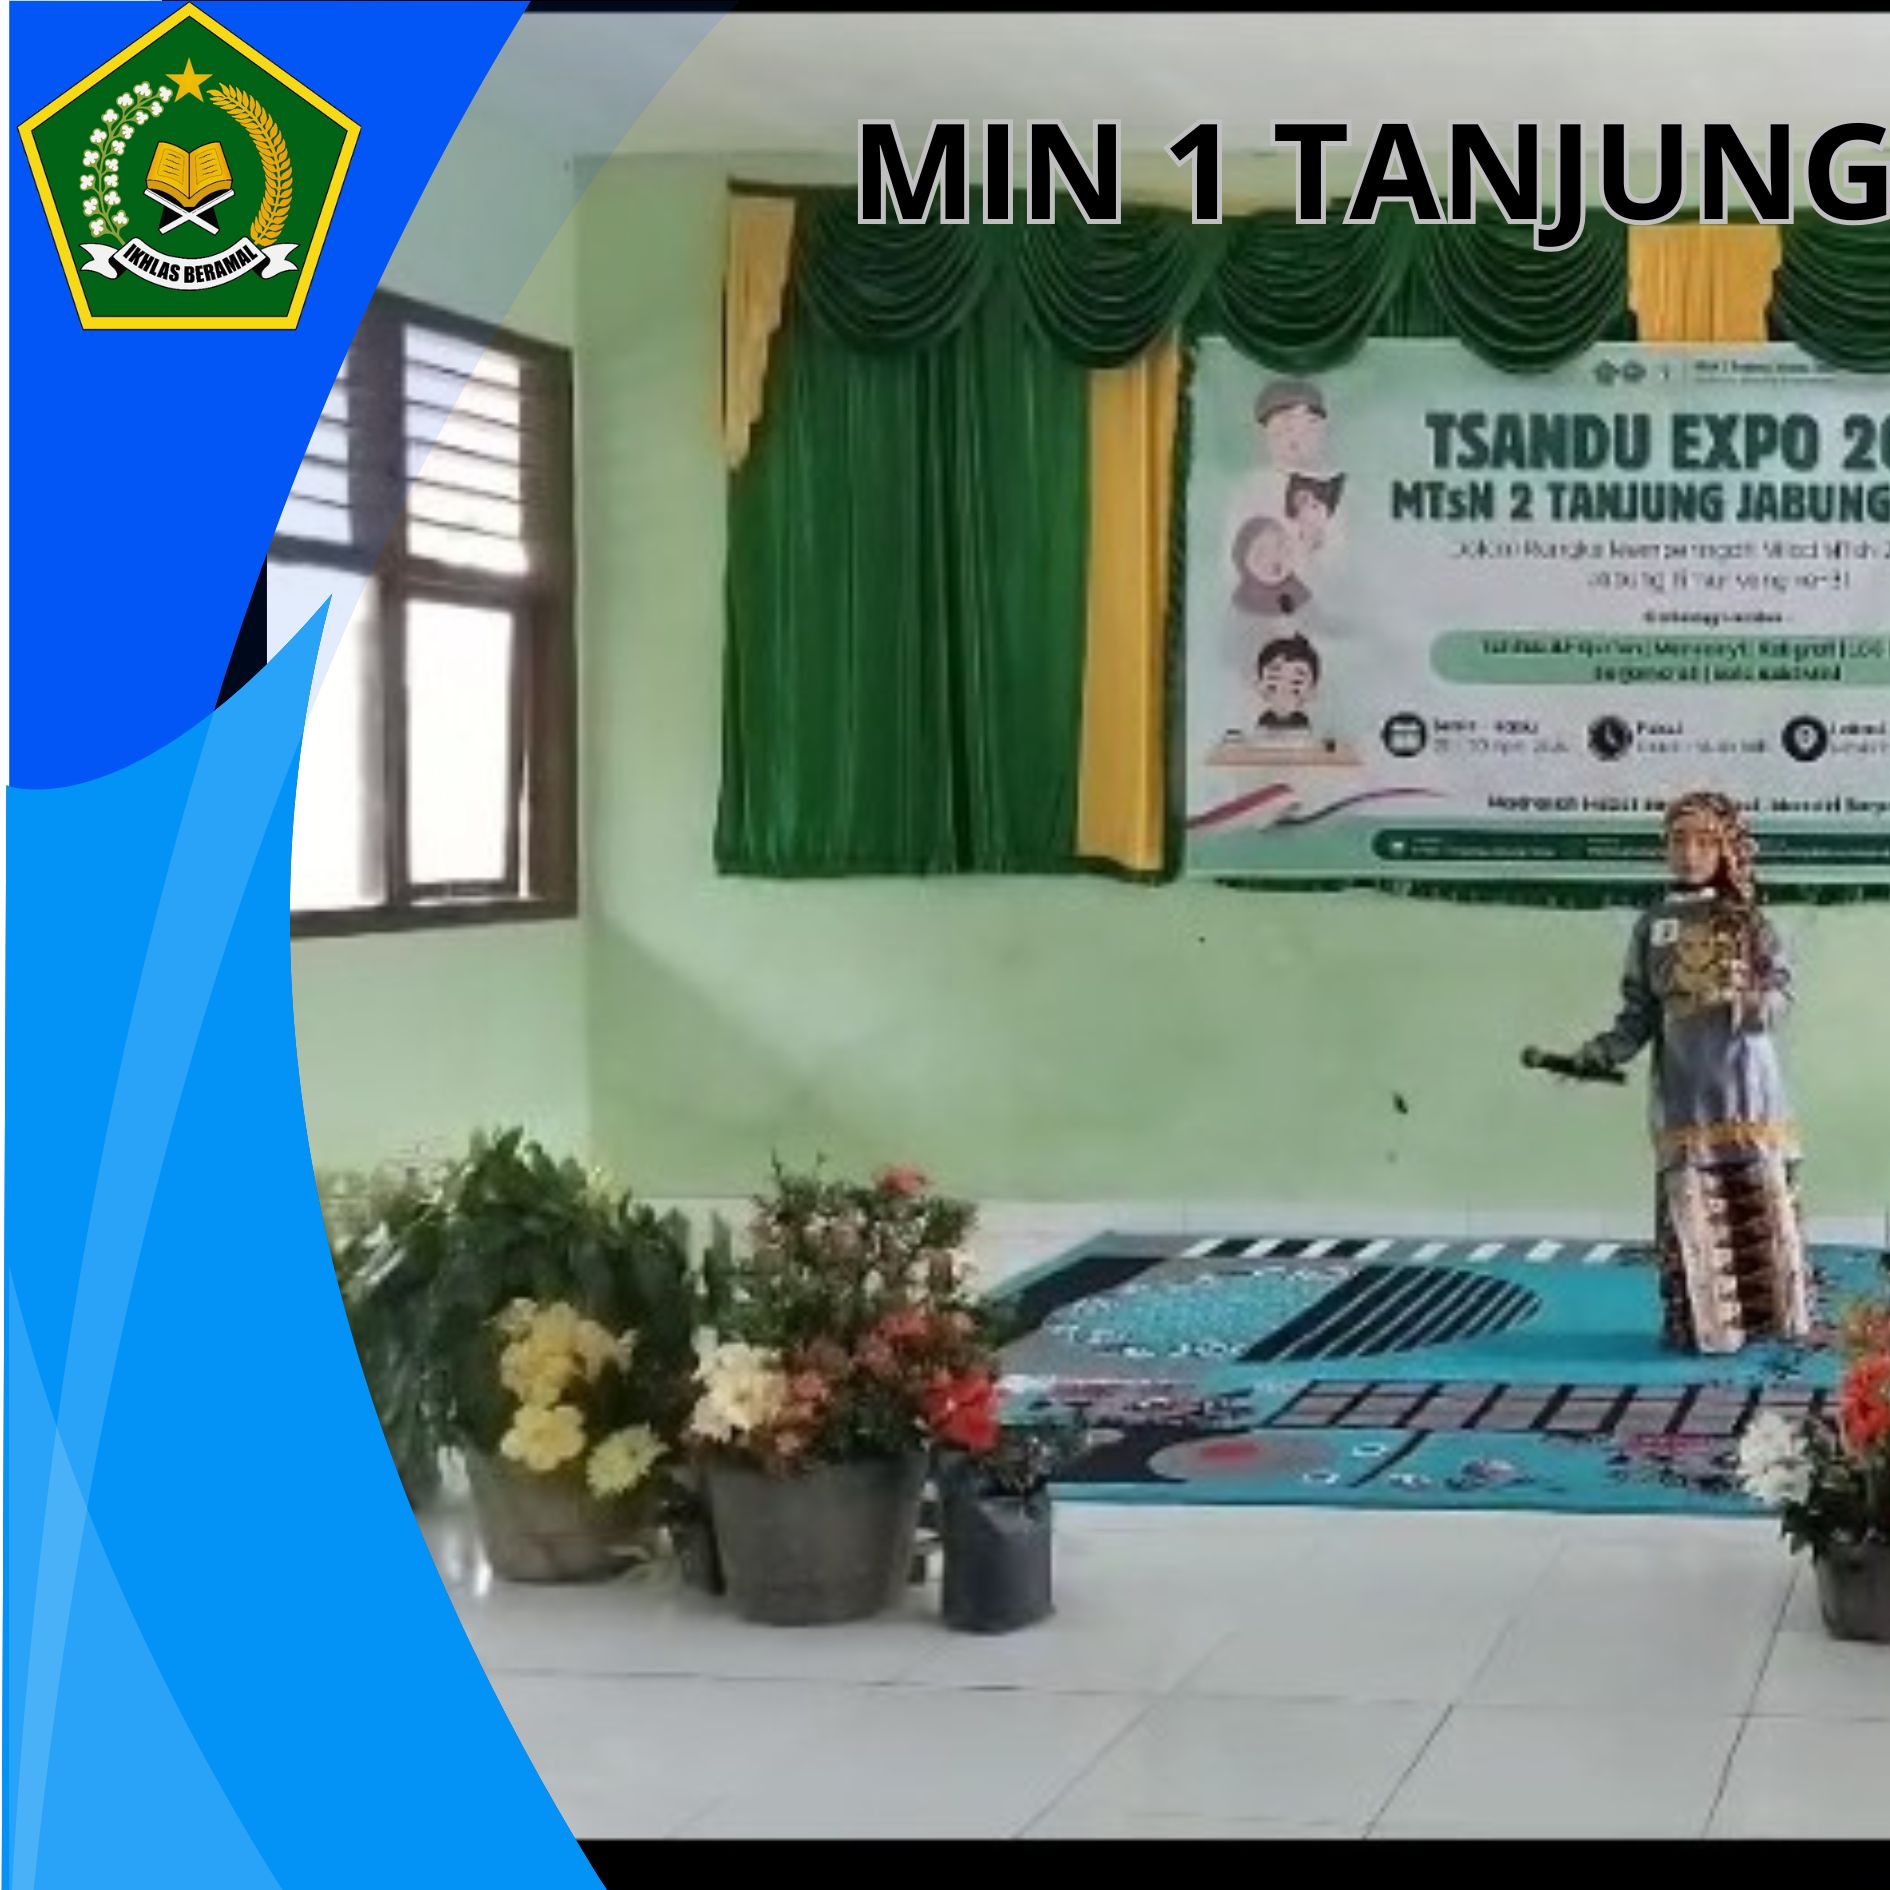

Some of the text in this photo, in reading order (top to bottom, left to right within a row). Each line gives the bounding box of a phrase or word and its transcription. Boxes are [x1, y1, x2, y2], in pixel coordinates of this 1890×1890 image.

[1425, 412, 1651, 471] TSANDU
[1671, 413, 1818, 471] EXPO
[1391, 481, 1495, 521] MTsN
[1510, 481, 1533, 521] 2
[1546, 481, 1724, 522] TANJUNG
